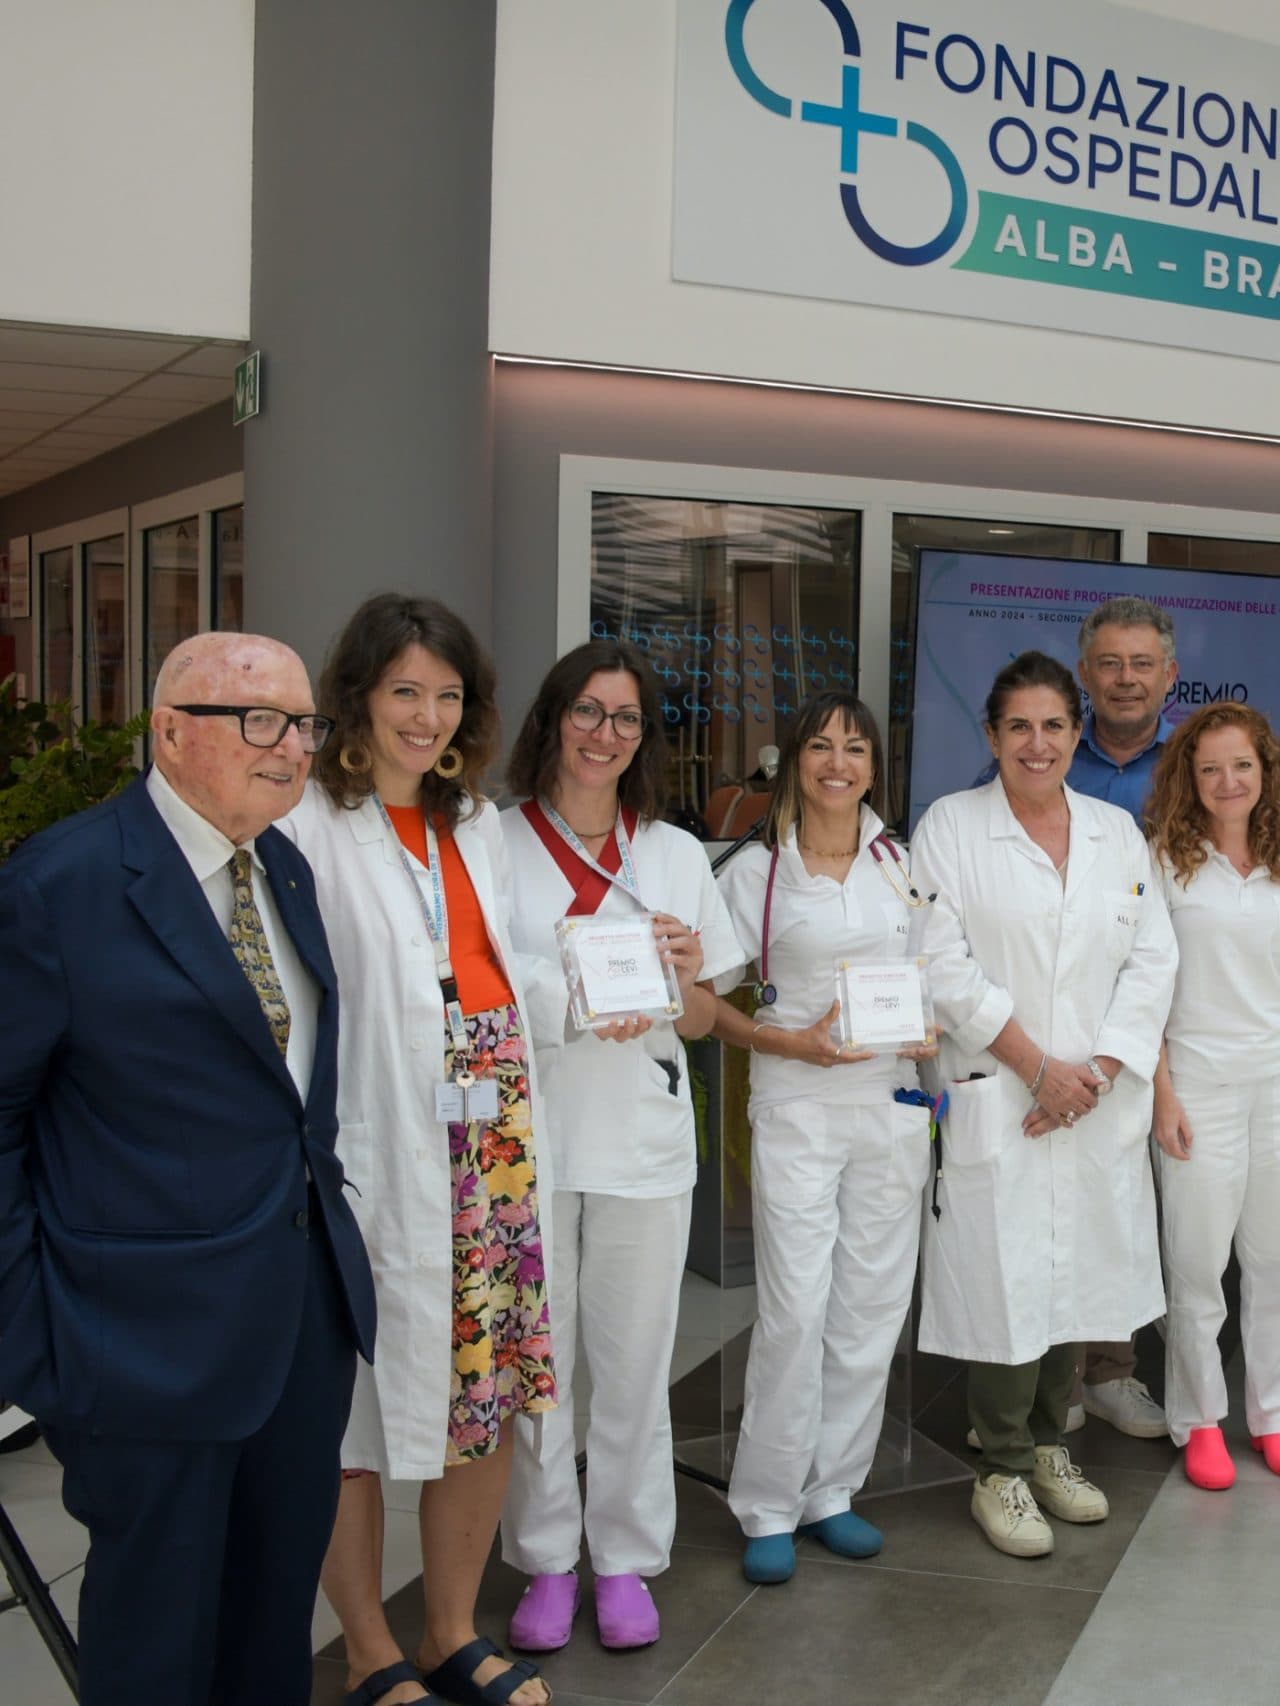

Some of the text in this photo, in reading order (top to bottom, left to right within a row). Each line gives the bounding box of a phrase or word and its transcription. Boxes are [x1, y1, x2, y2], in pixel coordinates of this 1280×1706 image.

[994, 214, 1133, 274] ALBA
[1159, 262, 1177, 272] -
[970, 582, 1071, 601] PRESENTAZIONE
[1149, 594, 1243, 613] UMANIZZAZIONE
[1245, 601, 1276, 615] DELLE
[968, 608, 997, 618] ANNO
[1001, 610, 1025, 620] 2024
[1038, 612, 1083, 624] SECONDA
[1165, 680, 1248, 705] PREMIO
